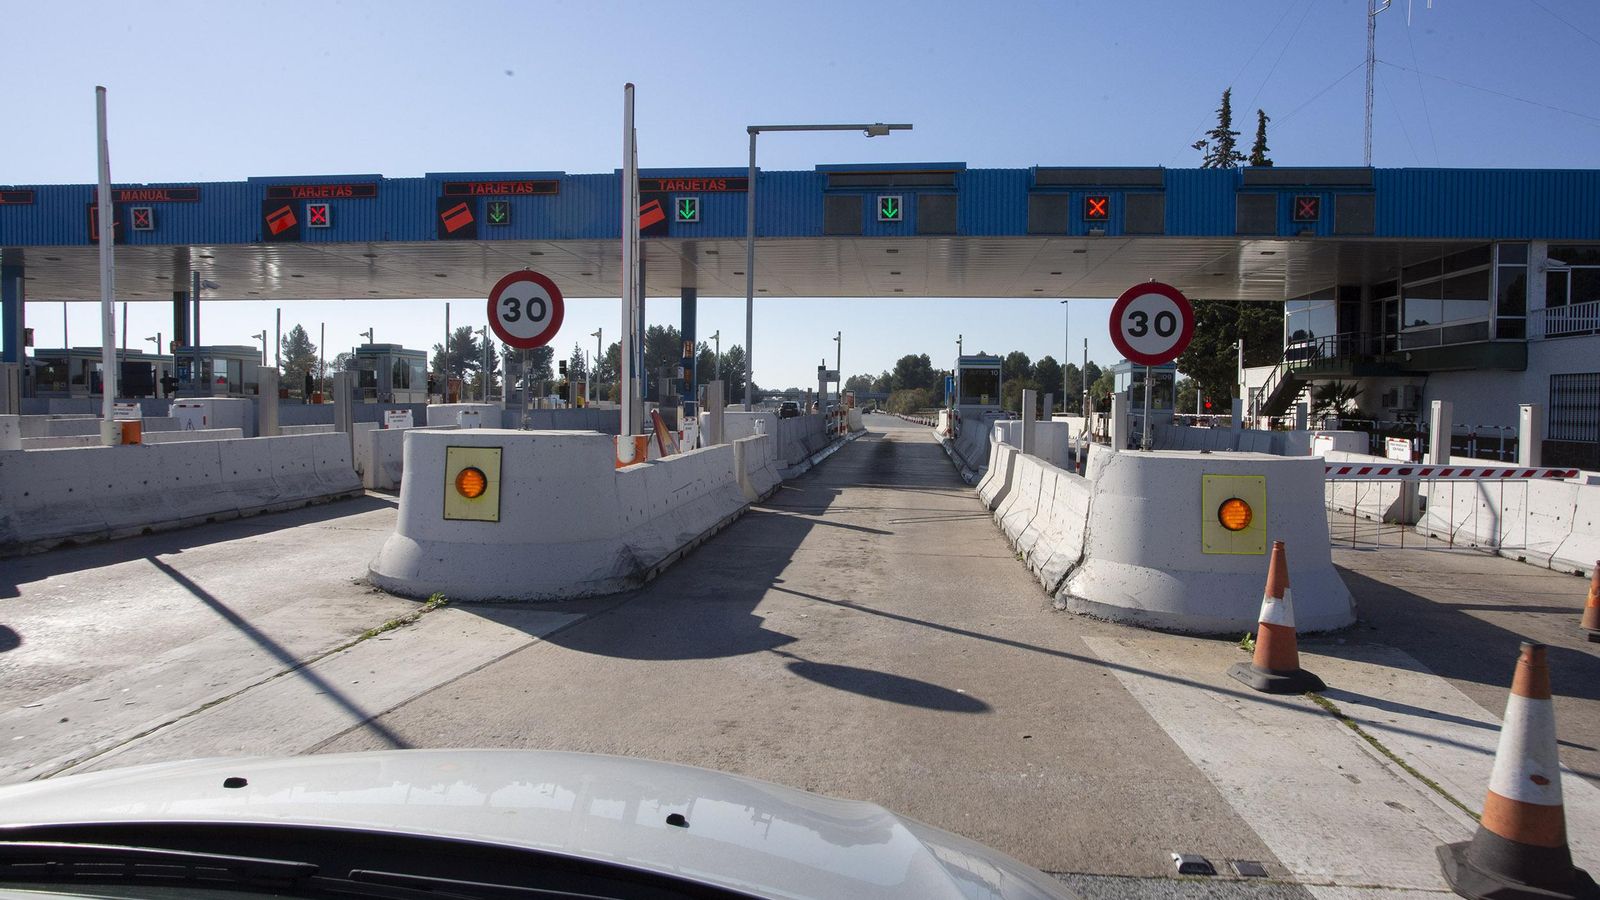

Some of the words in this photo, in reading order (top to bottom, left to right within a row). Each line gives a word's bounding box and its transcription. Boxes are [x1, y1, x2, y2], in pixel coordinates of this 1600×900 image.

[290, 184, 353, 198] TARJETAS
[468, 182, 533, 195] TARJETAS
[659, 178, 727, 191] TARJETAS
[121, 190, 170, 201] MANUAL
[502, 297, 547, 323] 30
[1128, 310, 1177, 338] 30
